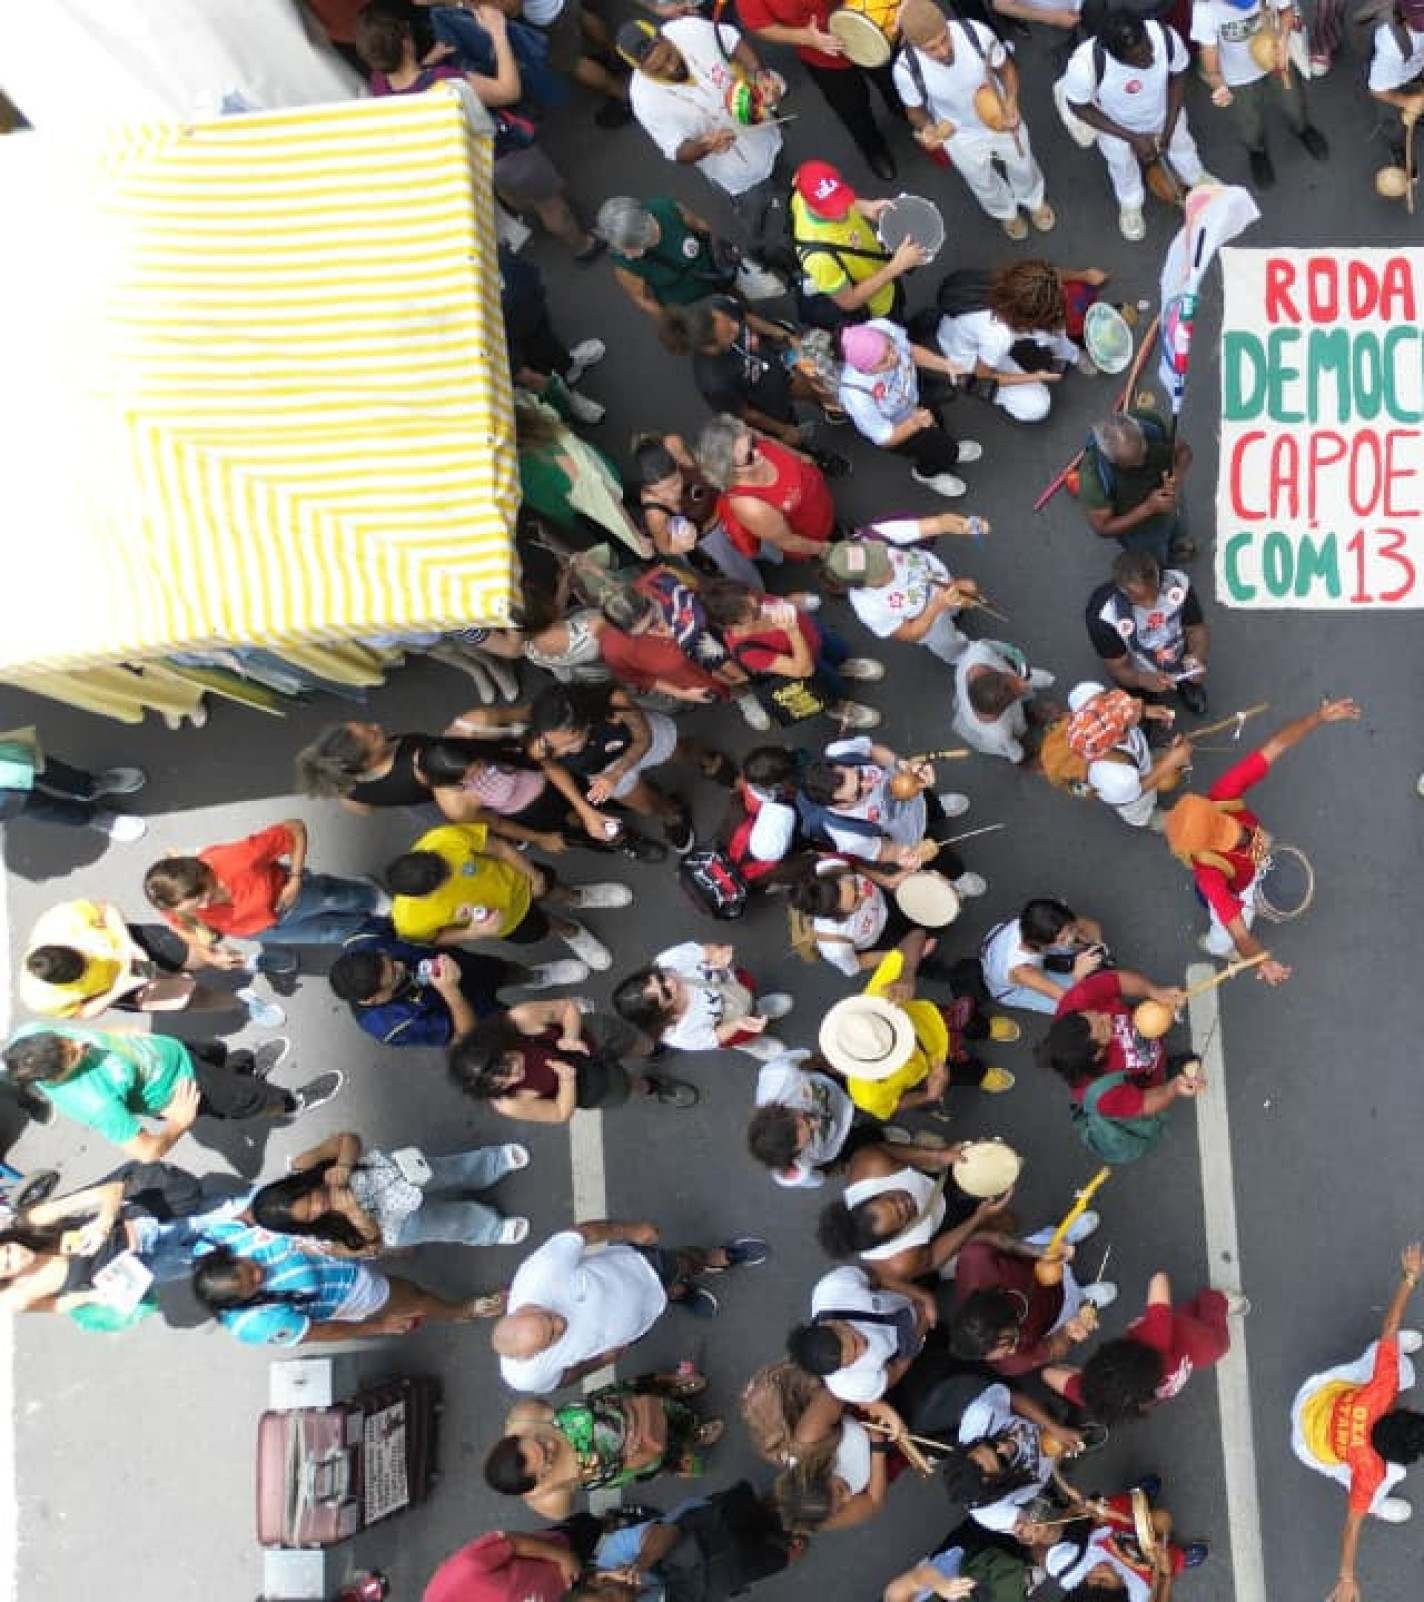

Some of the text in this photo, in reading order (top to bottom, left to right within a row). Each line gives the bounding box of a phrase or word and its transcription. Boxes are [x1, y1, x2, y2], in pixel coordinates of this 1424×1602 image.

[1264, 256, 1417, 324] RODA
[1225, 530, 1342, 602] COM
[1346, 527, 1417, 603] 13
